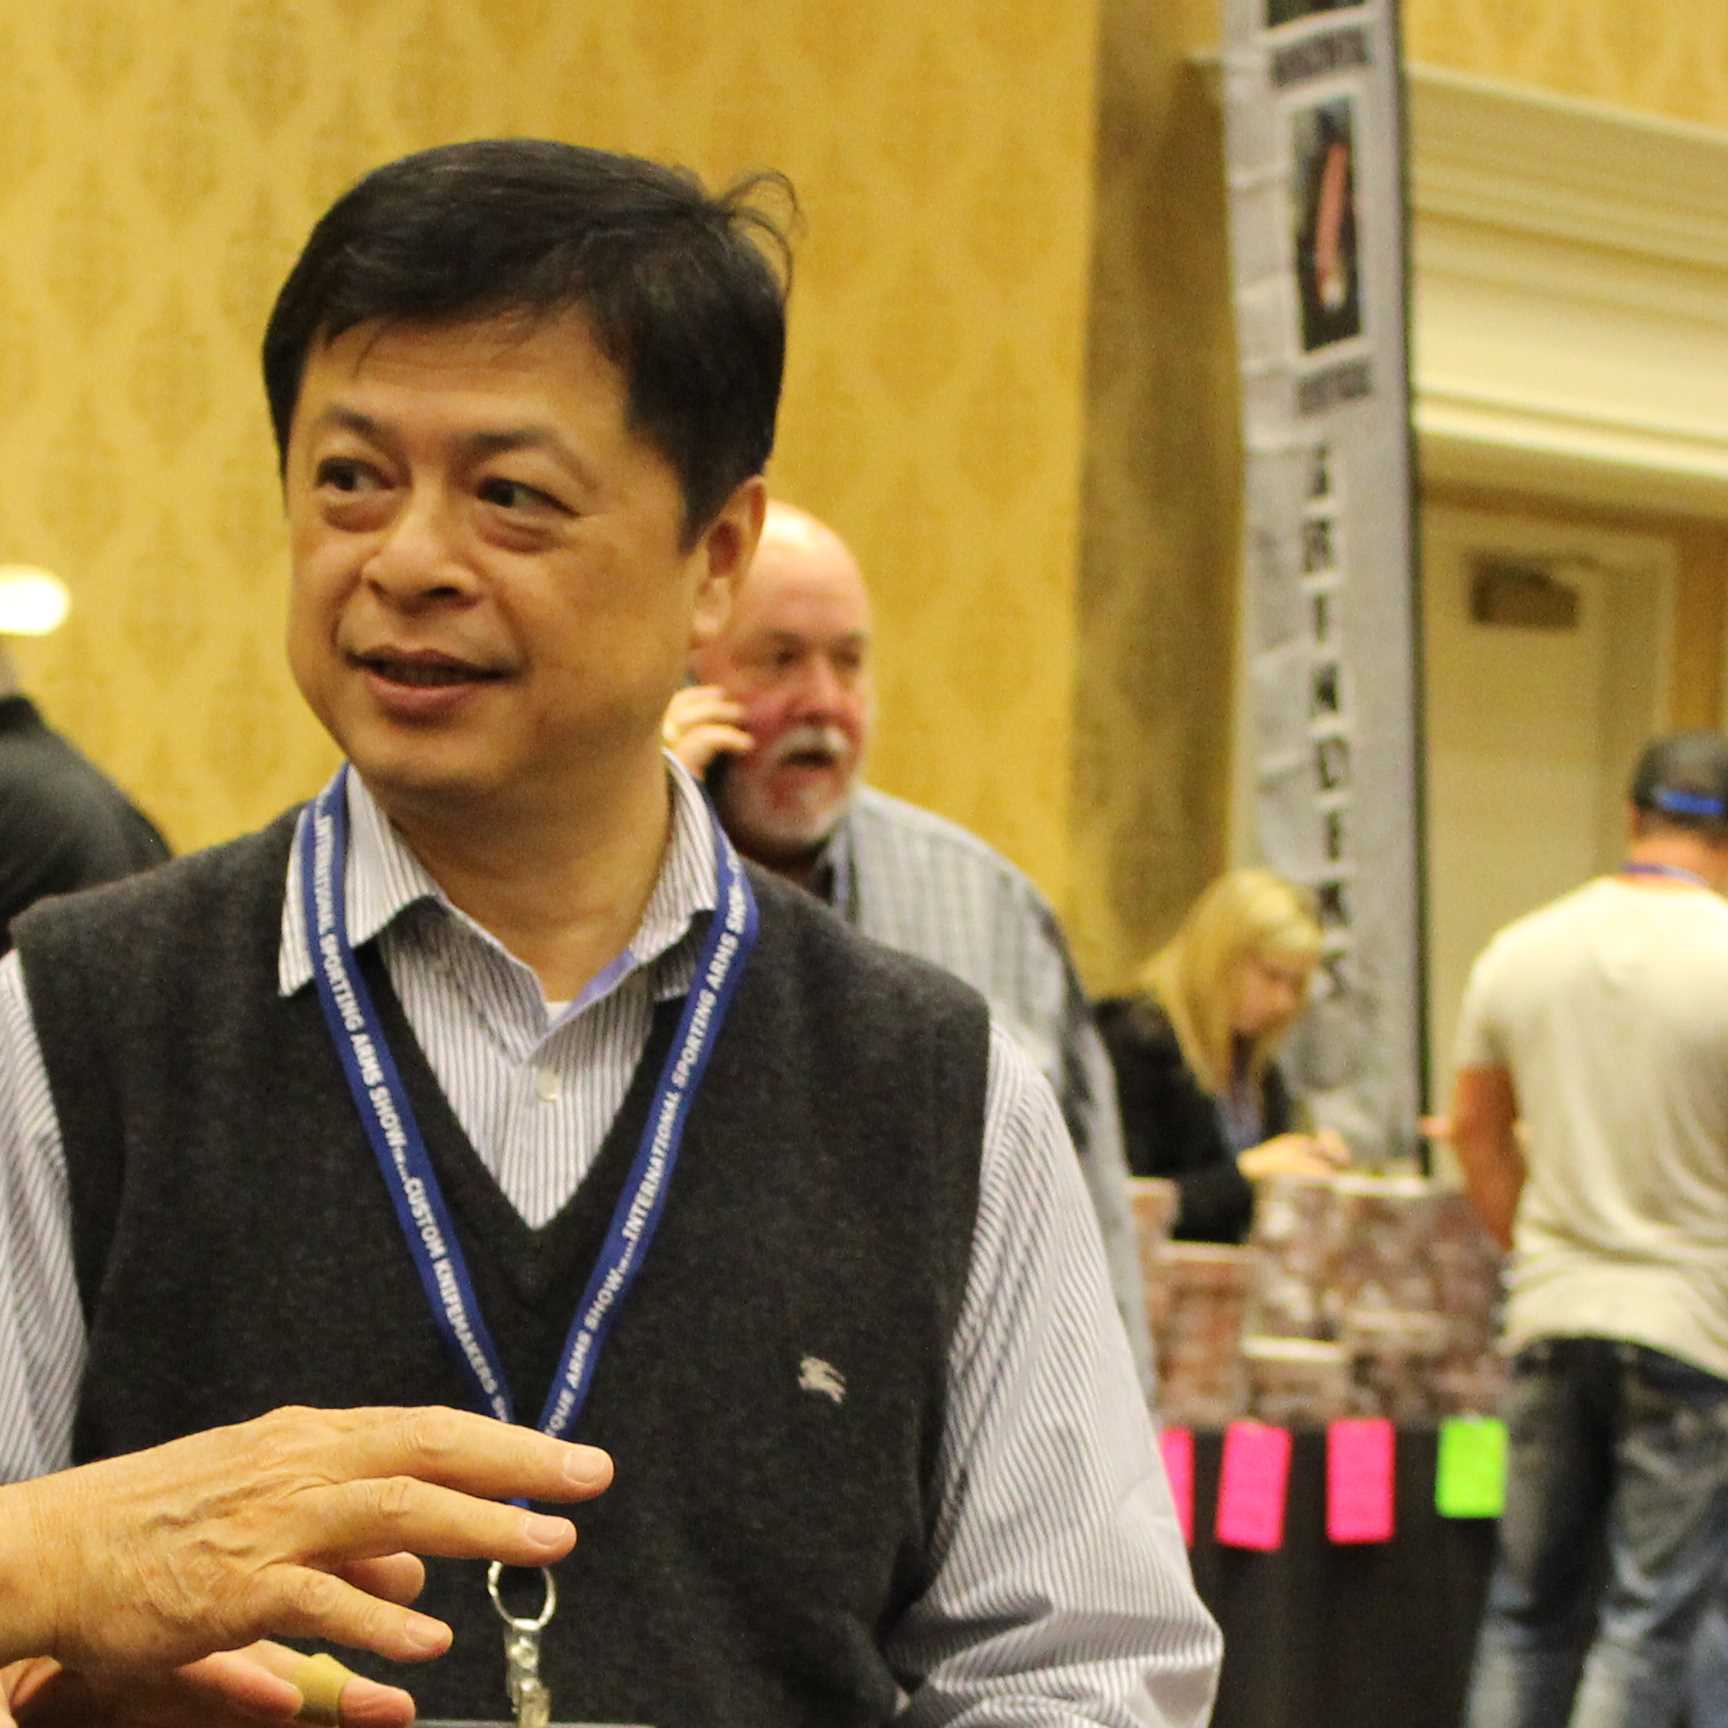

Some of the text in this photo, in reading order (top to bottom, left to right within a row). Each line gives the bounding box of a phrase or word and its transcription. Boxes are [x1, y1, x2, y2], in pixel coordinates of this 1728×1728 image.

[319, 933, 365, 1032] SPORTING
[350, 1033, 384, 1087] ARMS
[433, 1258, 498, 1395] KNIFEMAKERS
[565, 1329, 592, 1390] ARMS
[672, 988, 718, 1089] SPORTING
[705, 931, 739, 991] ARMS
